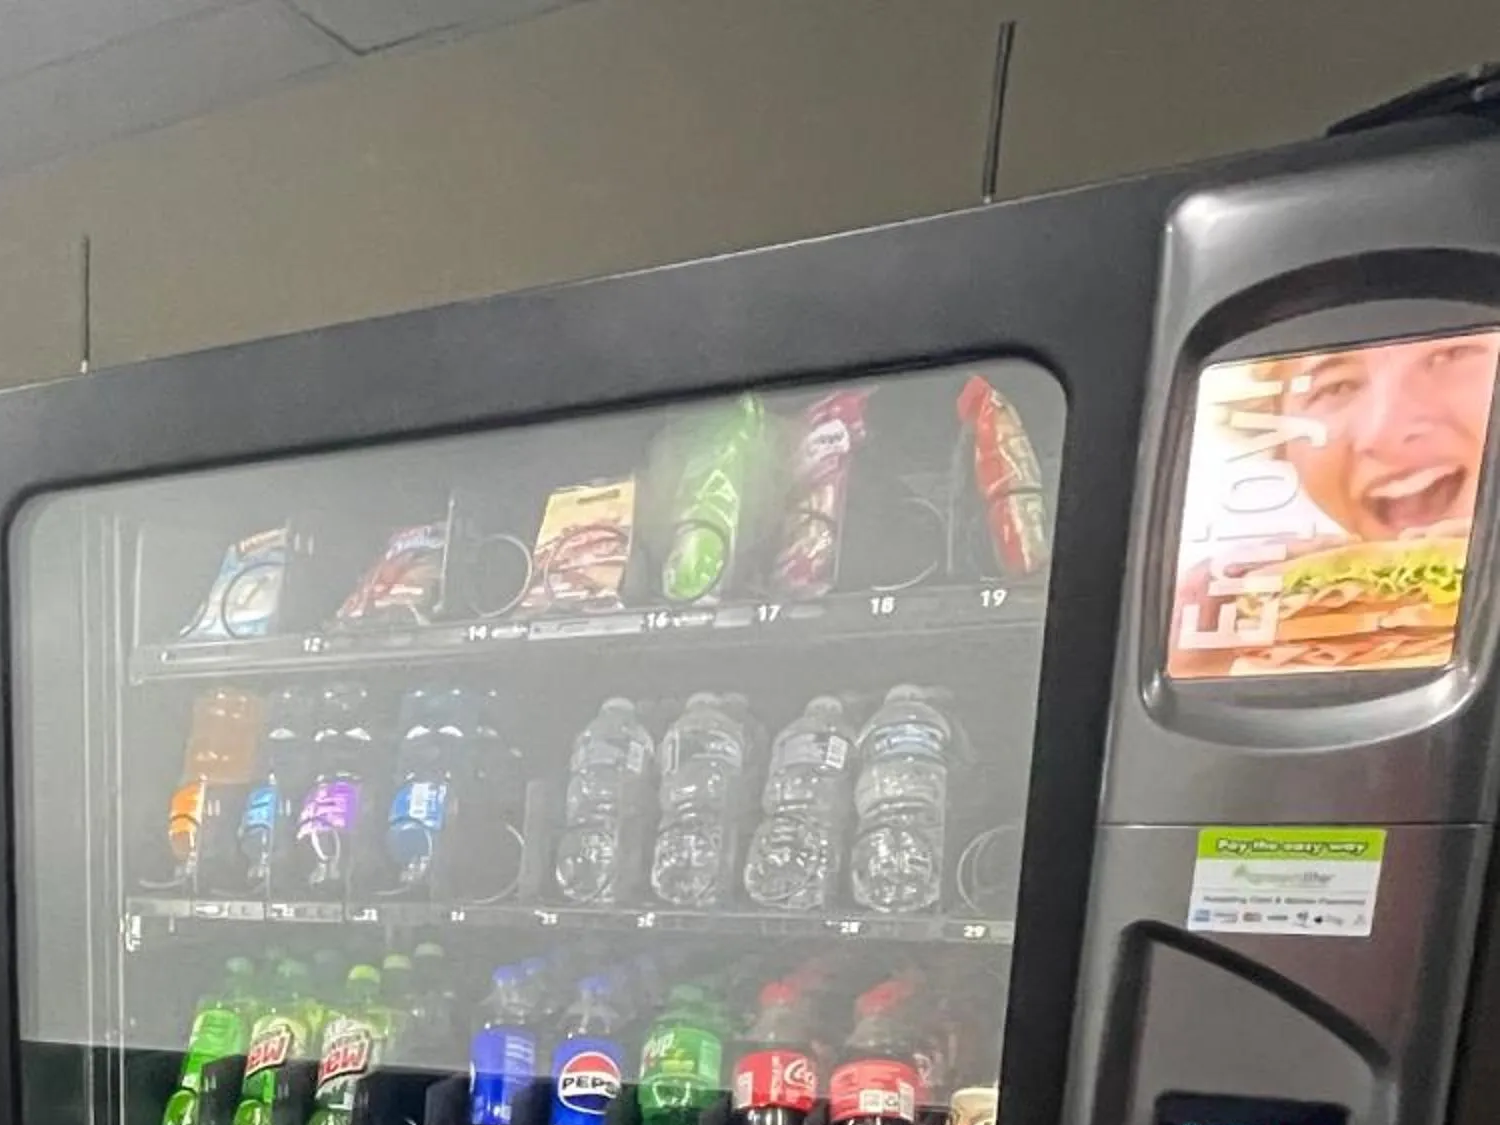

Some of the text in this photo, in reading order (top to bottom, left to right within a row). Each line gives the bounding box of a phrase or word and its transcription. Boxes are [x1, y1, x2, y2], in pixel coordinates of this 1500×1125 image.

[870, 596, 895, 616] 18
[979, 588, 1007, 608] 19
[648, 612, 668, 629] 16
[757, 604, 781, 623] 17
[562, 1076, 621, 1098] PEPS
